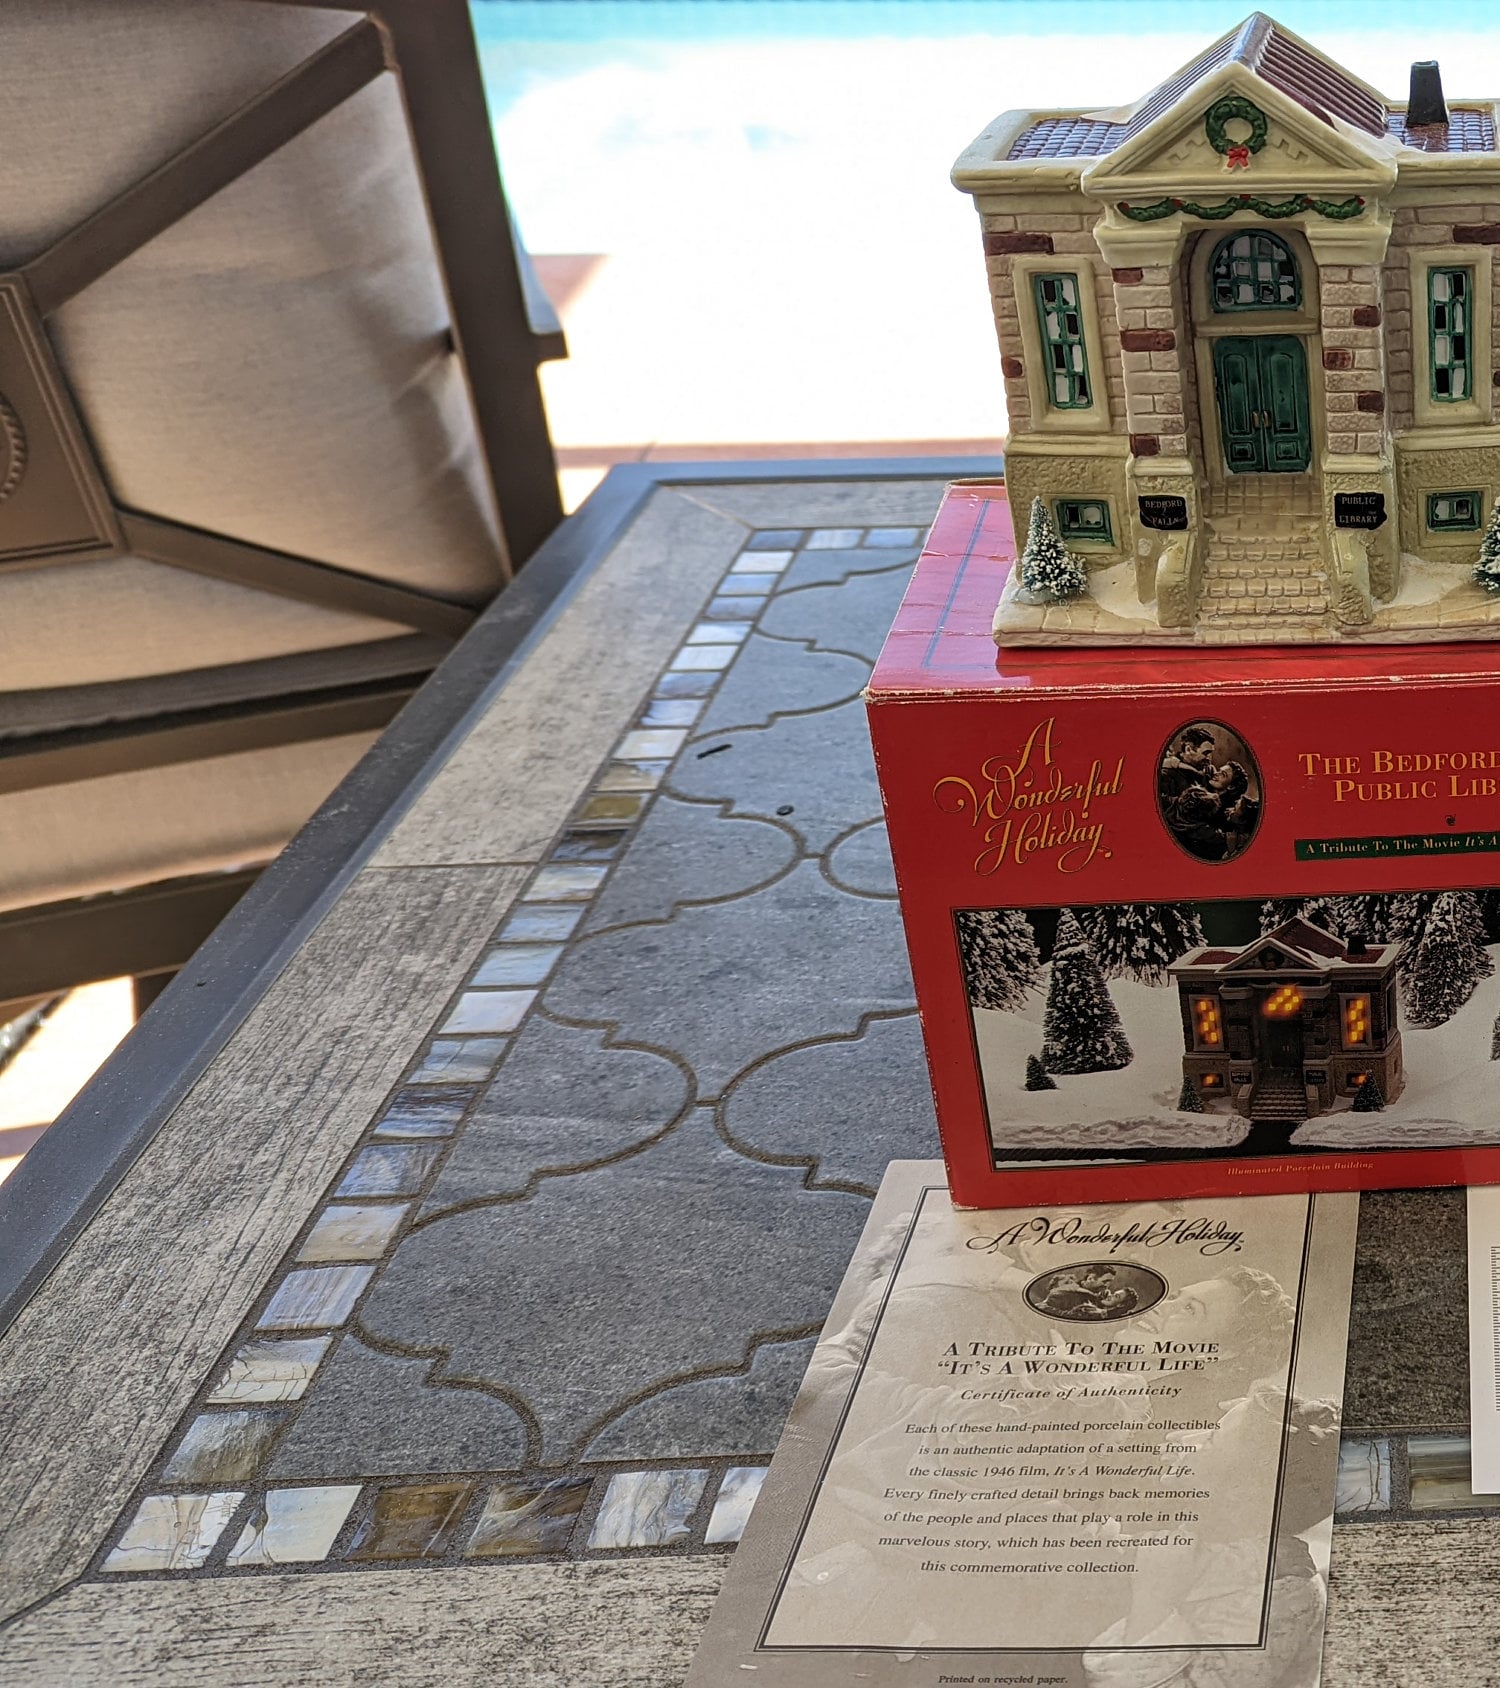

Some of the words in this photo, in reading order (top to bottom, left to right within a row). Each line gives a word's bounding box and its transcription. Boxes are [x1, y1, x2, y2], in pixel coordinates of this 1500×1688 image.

[1145, 500, 1183, 508] BEDFORD
[1342, 496, 1376, 504] PUBLIC
[1339, 515, 1378, 524] LIBRARY
[982, 717, 1061, 787] A
[1298, 754, 1361, 776] THE
[933, 754, 1125, 826] Wonderful
[1333, 780, 1437, 802] PUBLIC
[974, 808, 1112, 876] Holiday
[1306, 844, 1315, 854] A
[1320, 842, 1368, 853] Tribute
[1373, 840, 1389, 851] To
[1393, 840, 1418, 850] The
[1423, 838, 1460, 849] Movie
[1465, 836, 1485, 847] It's
[1489, 836, 1497, 846] A
[1227, 1166, 1282, 1175] Illuminated
[1286, 1163, 1331, 1172] Porcelain
[1334, 1161, 1374, 1170] Building
[966, 1222, 1031, 1254] A
[1030, 1217, 1151, 1254] Wonderful
[942, 1342, 960, 1356] A
[968, 1342, 1057, 1356] TRIBUTE
[1066, 1342, 1094, 1355] TO
[1102, 1342, 1145, 1355] THE
[1152, 1341, 1220, 1354] MOVIE
[998, 1361, 1014, 1374] A
[1025, 1360, 1151, 1374] WONDERFUL
[960, 1388, 1051, 1402] Certificate
[1056, 1387, 1076, 1400] of
[1078, 1385, 1182, 1398] Authenticity
[905, 1424, 937, 1434] Each
[941, 1424, 958, 1434] of
[958, 1424, 992, 1433] these
[996, 1422, 1080, 1434] hand-painted
[1083, 1420, 1143, 1433] porcelain
[1148, 1420, 1221, 1430] collectibles
[919, 1446, 930, 1454] is
[953, 1445, 1013, 1454] authentic
[1016, 1444, 1084, 1455] adaptation
[1089, 1443, 1104, 1453] of
[1118, 1444, 1161, 1455] setting
[1165, 1443, 1197, 1453] from
[909, 1467, 930, 1476] the
[934, 1467, 978, 1476] classic
[983, 1466, 1015, 1476] 1946
[1018, 1466, 1050, 1477] film,
[1054, 1466, 1076, 1476] It's
[1079, 1466, 1089, 1476] A
[1096, 1466, 1164, 1478] Wonderful
[1166, 1466, 1196, 1477] Life.
[884, 1488, 924, 1501] Every
[928, 1490, 967, 1502] finely
[970, 1489, 1018, 1500] crafted
[1021, 1488, 1059, 1499] detail
[1063, 1488, 1104, 1500] brings
[1109, 1488, 1140, 1498] back
[1145, 1488, 1210, 1498] memories
[884, 1512, 900, 1522] of
[902, 1512, 924, 1522] the
[926, 1514, 973, 1526] people
[977, 1514, 1002, 1524] and
[1004, 1513, 1048, 1526] places
[1052, 1512, 1078, 1523] that
[1080, 1512, 1110, 1526] play
[1126, 1512, 1153, 1522] role
[1158, 1512, 1170, 1522] in
[1174, 1512, 1199, 1522] this
[878, 1536, 950, 1547] marvelous
[954, 1538, 992, 1550] story,
[997, 1537, 1038, 1548] which
[1042, 1538, 1065, 1548] has
[1070, 1537, 1102, 1548] been
[1106, 1536, 1169, 1547] recreated
[1173, 1536, 1194, 1546] for
[920, 1561, 946, 1572] this
[950, 1562, 1062, 1573] commemorative
[1066, 1562, 1139, 1573] collection.
[939, 1675, 975, 1684] Printed
[994, 1675, 1034, 1686] recycled
[1037, 1677, 1068, 1686] paper.
